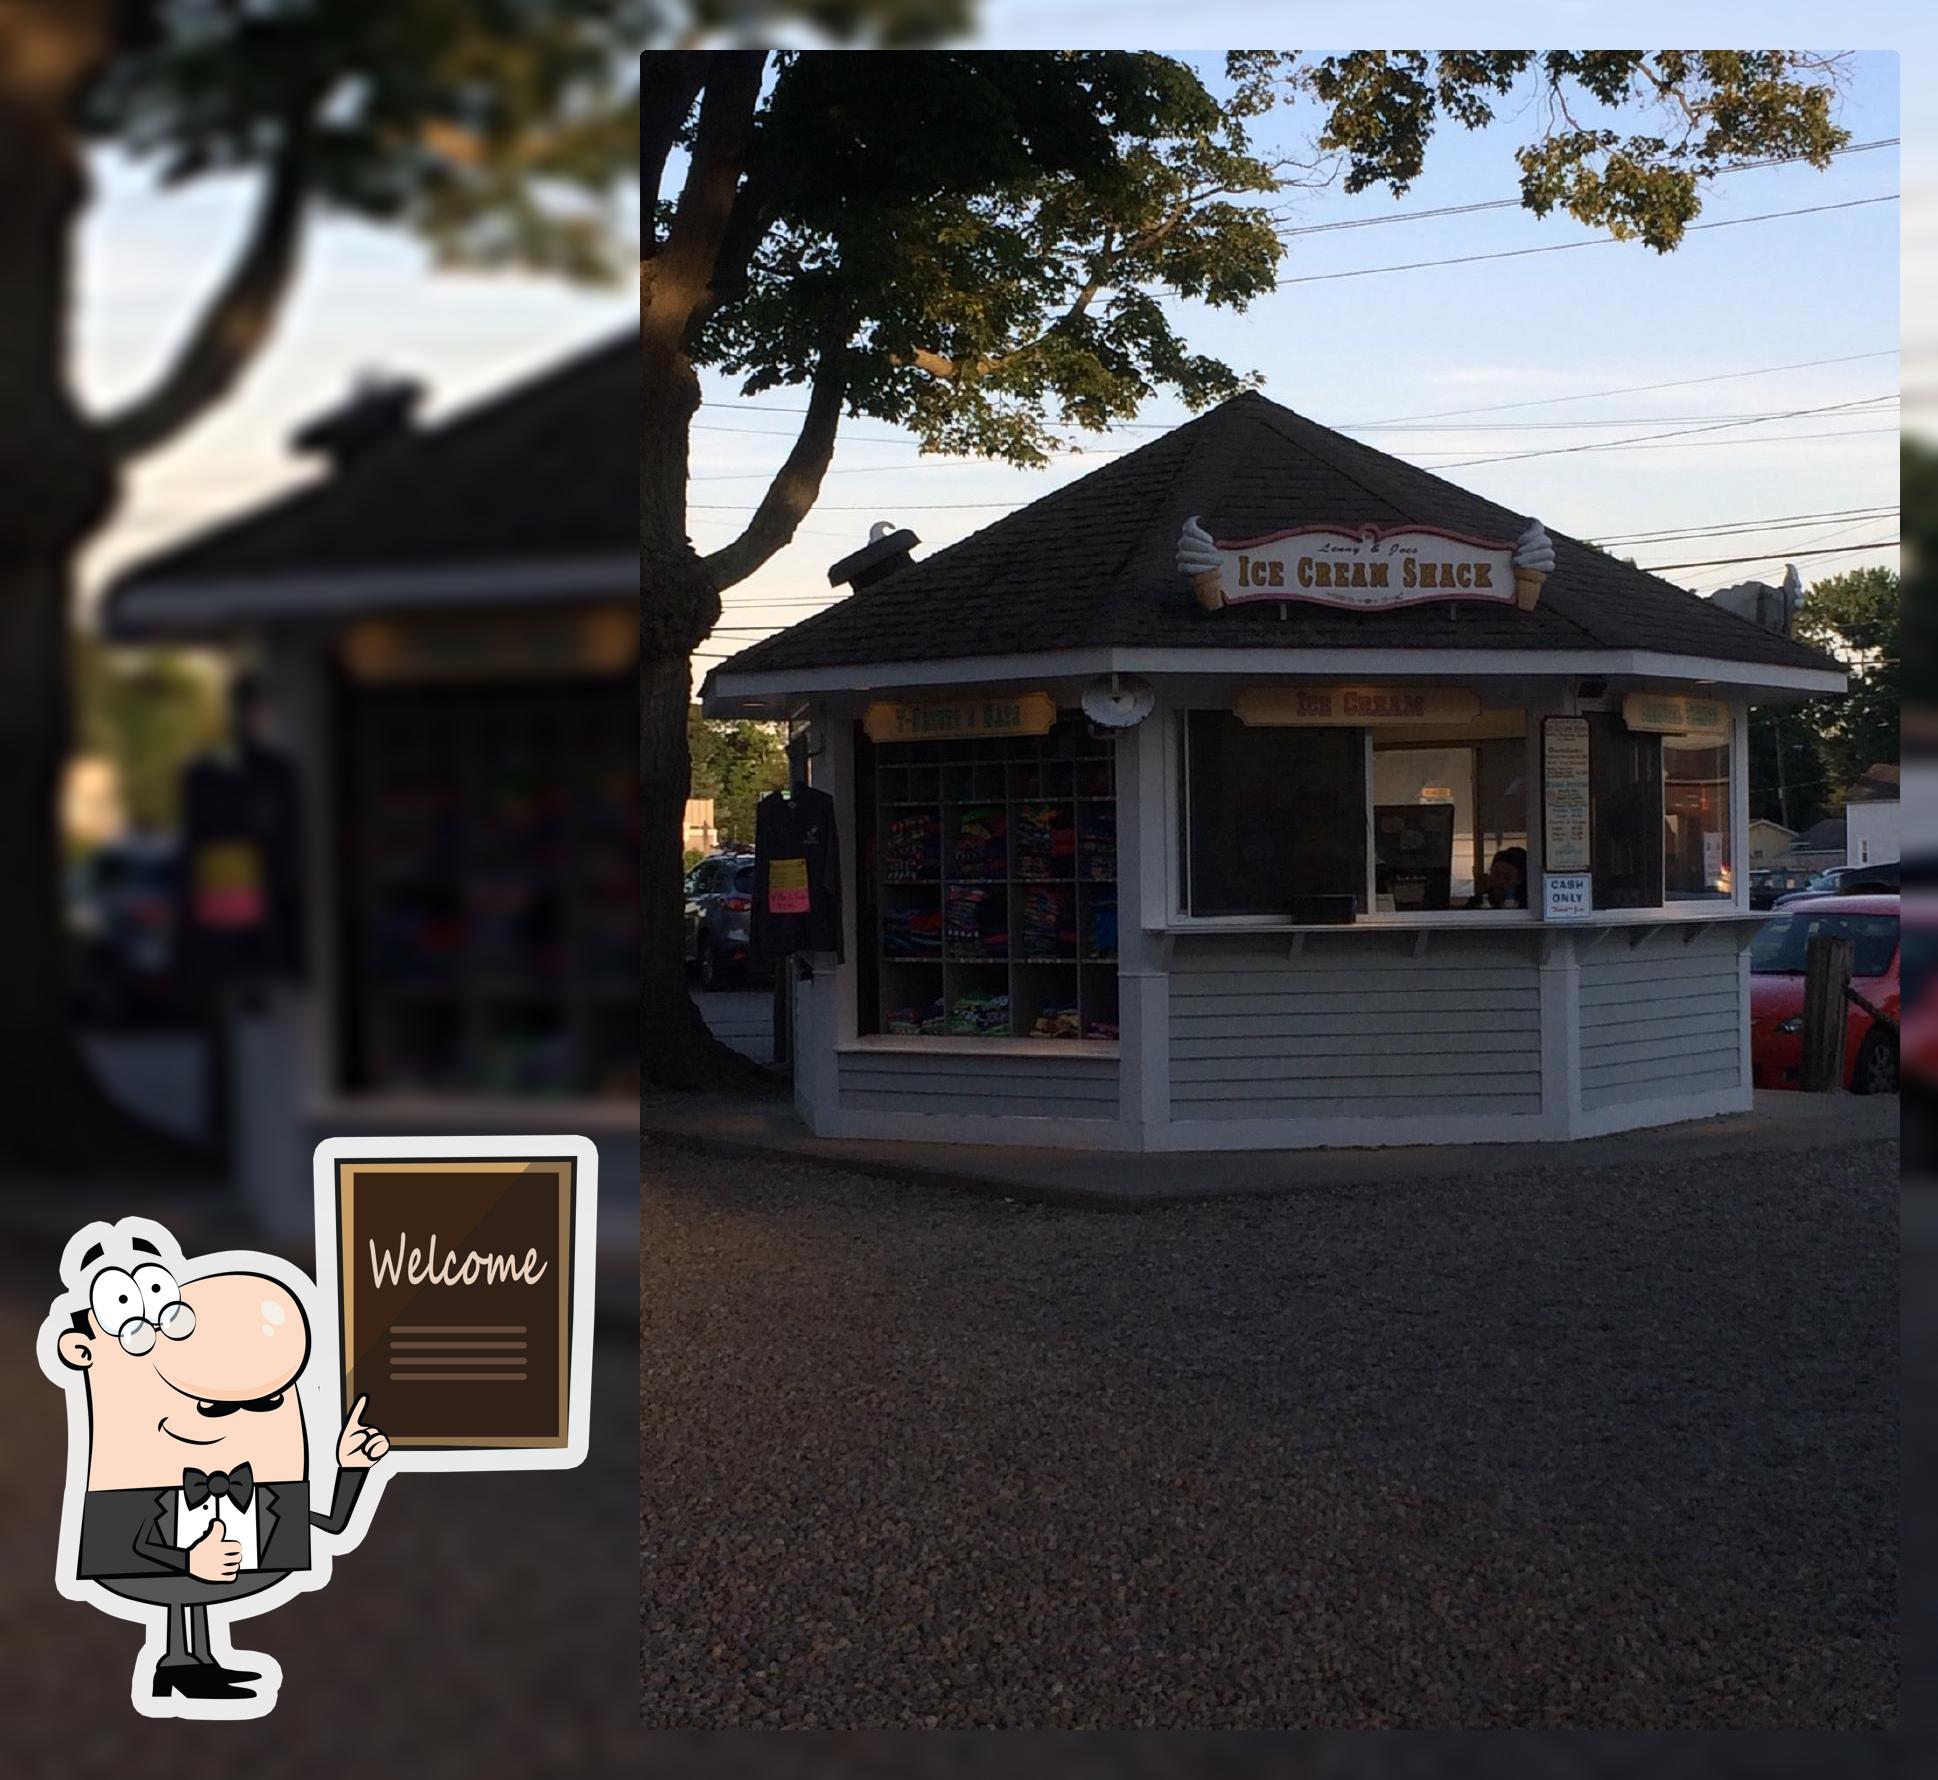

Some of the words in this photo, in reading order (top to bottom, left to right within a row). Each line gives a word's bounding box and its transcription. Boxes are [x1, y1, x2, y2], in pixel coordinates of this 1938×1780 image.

[1317, 542, 1360, 556] Lenny
[1370, 543, 1380, 553] &
[1238, 555, 1285, 587] ICE
[1297, 556, 1390, 588] CREAM
[1402, 557, 1493, 589] SHACK
[1296, 691, 1332, 717] ICE
[1344, 691, 1425, 717] CREAM
[1551, 879, 1583, 889] CASH
[1552, 893, 1582, 903] ONLY
